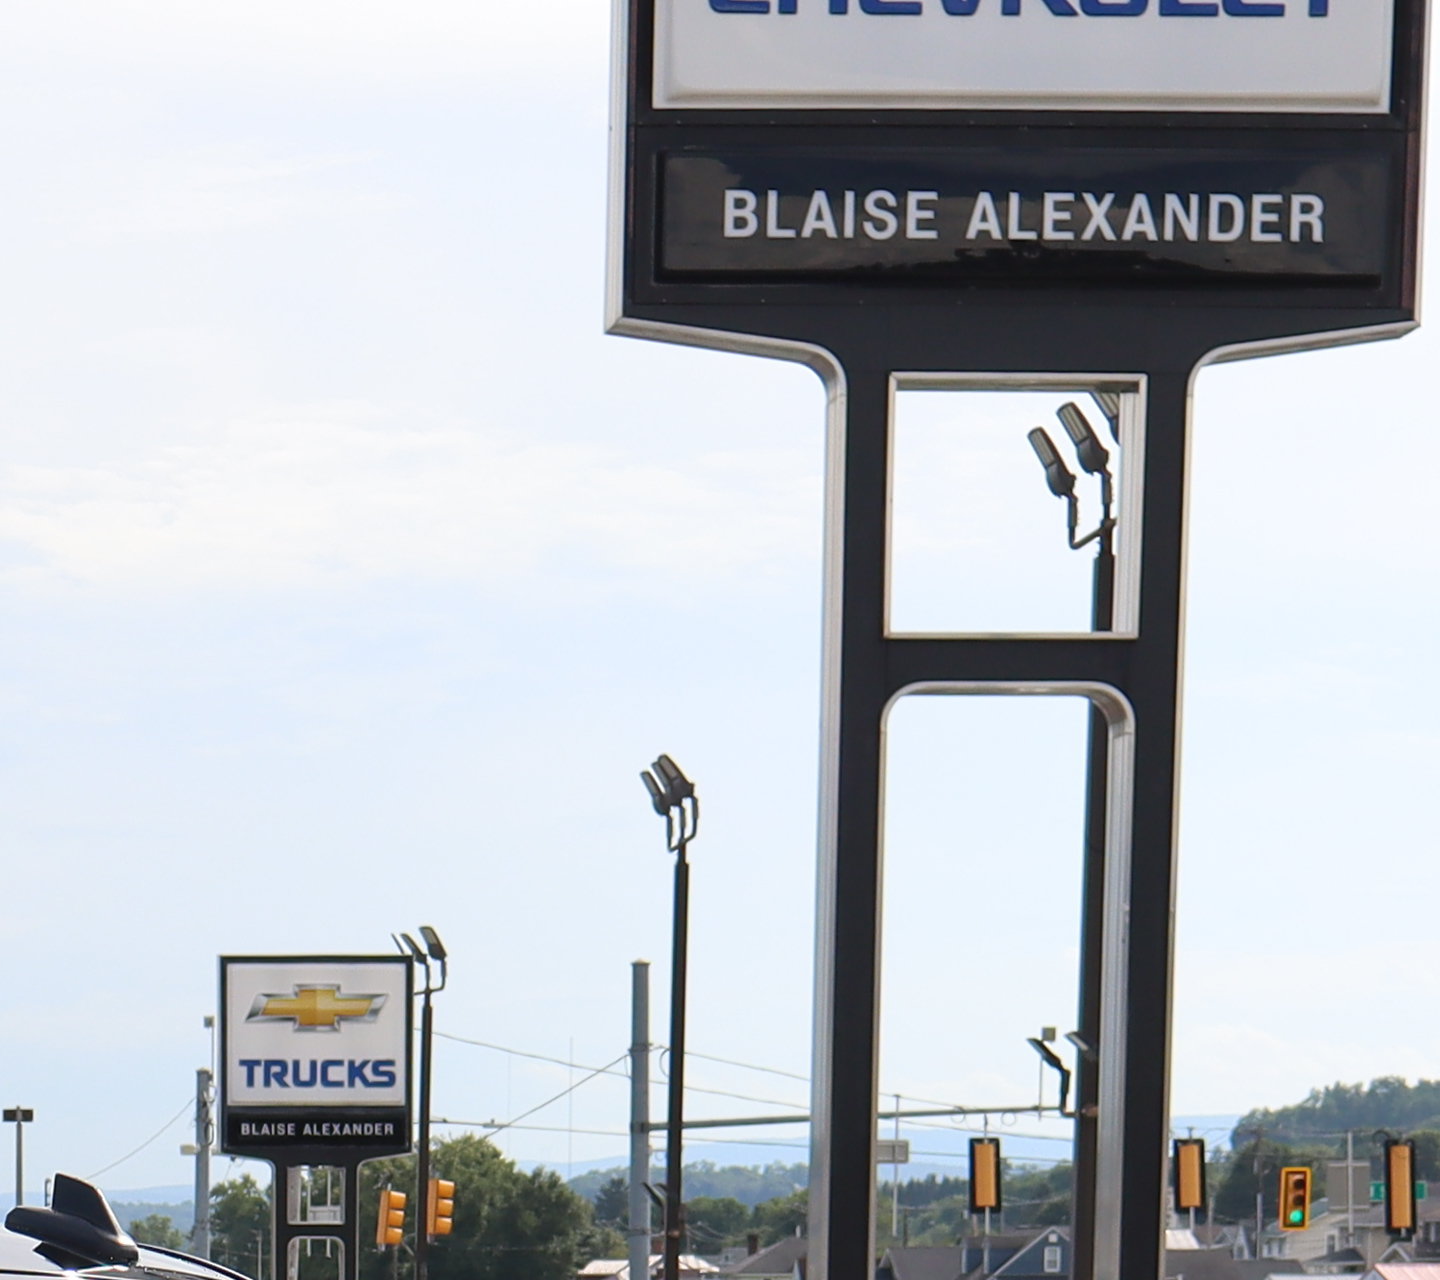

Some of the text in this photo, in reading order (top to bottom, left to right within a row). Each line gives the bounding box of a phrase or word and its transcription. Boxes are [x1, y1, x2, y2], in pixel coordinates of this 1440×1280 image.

[723, 189, 1325, 244] BLAISE ALEXANDER
[238, 1059, 397, 1089] TRUCKS
[240, 1122, 395, 1137] BLAISE ALEXANDER
